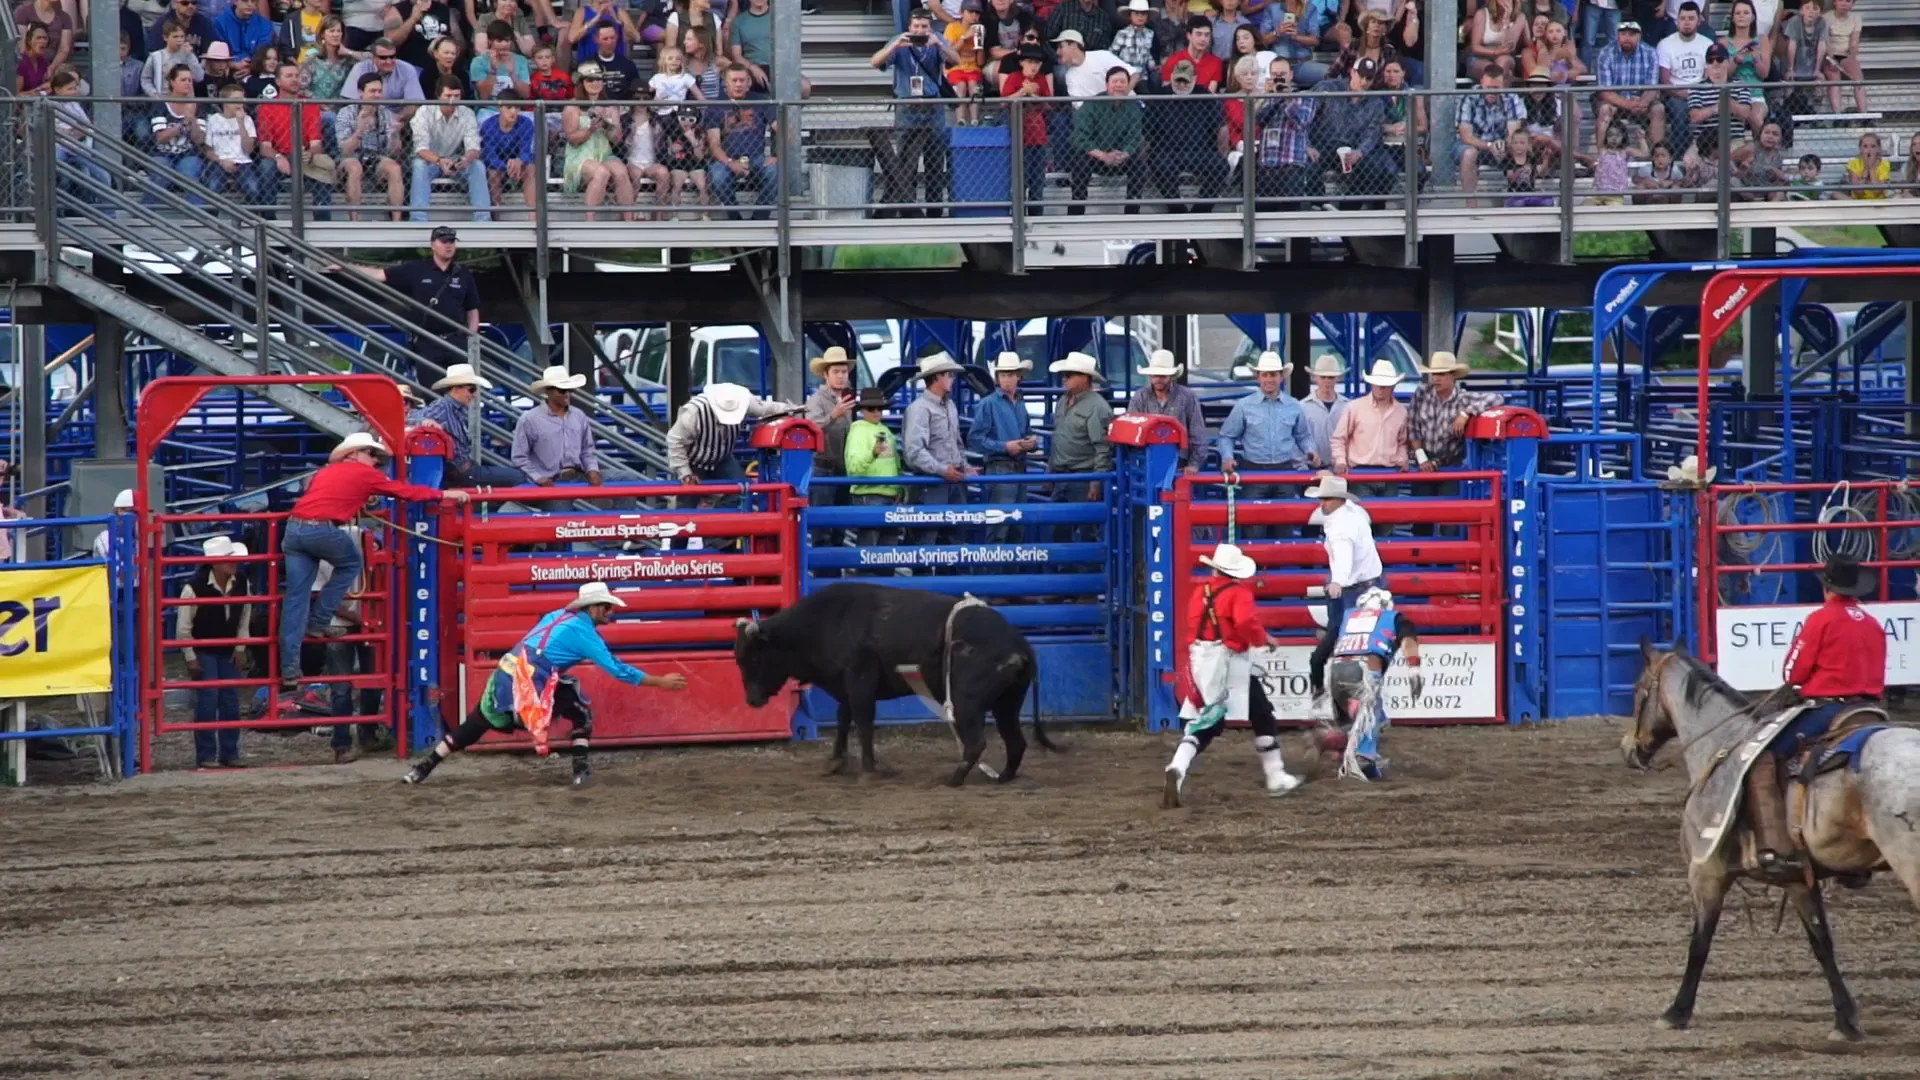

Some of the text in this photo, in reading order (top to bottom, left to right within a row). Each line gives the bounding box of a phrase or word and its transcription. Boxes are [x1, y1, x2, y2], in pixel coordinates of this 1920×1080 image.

[885, 510, 986, 524] Steamboat Springs
[555, 524, 660, 538] Steamboat Springs
[860, 546, 1049, 566] Steamboat Springs ProRodeo Series
[531, 560, 724, 581] Steamboat Springs ProRodeo Series
[1510, 499, 1526, 656] Priefert
[415, 522, 430, 681] Priefert
[1440, 652, 1477, 671] Only
[1431, 671, 1474, 687] Hotel
